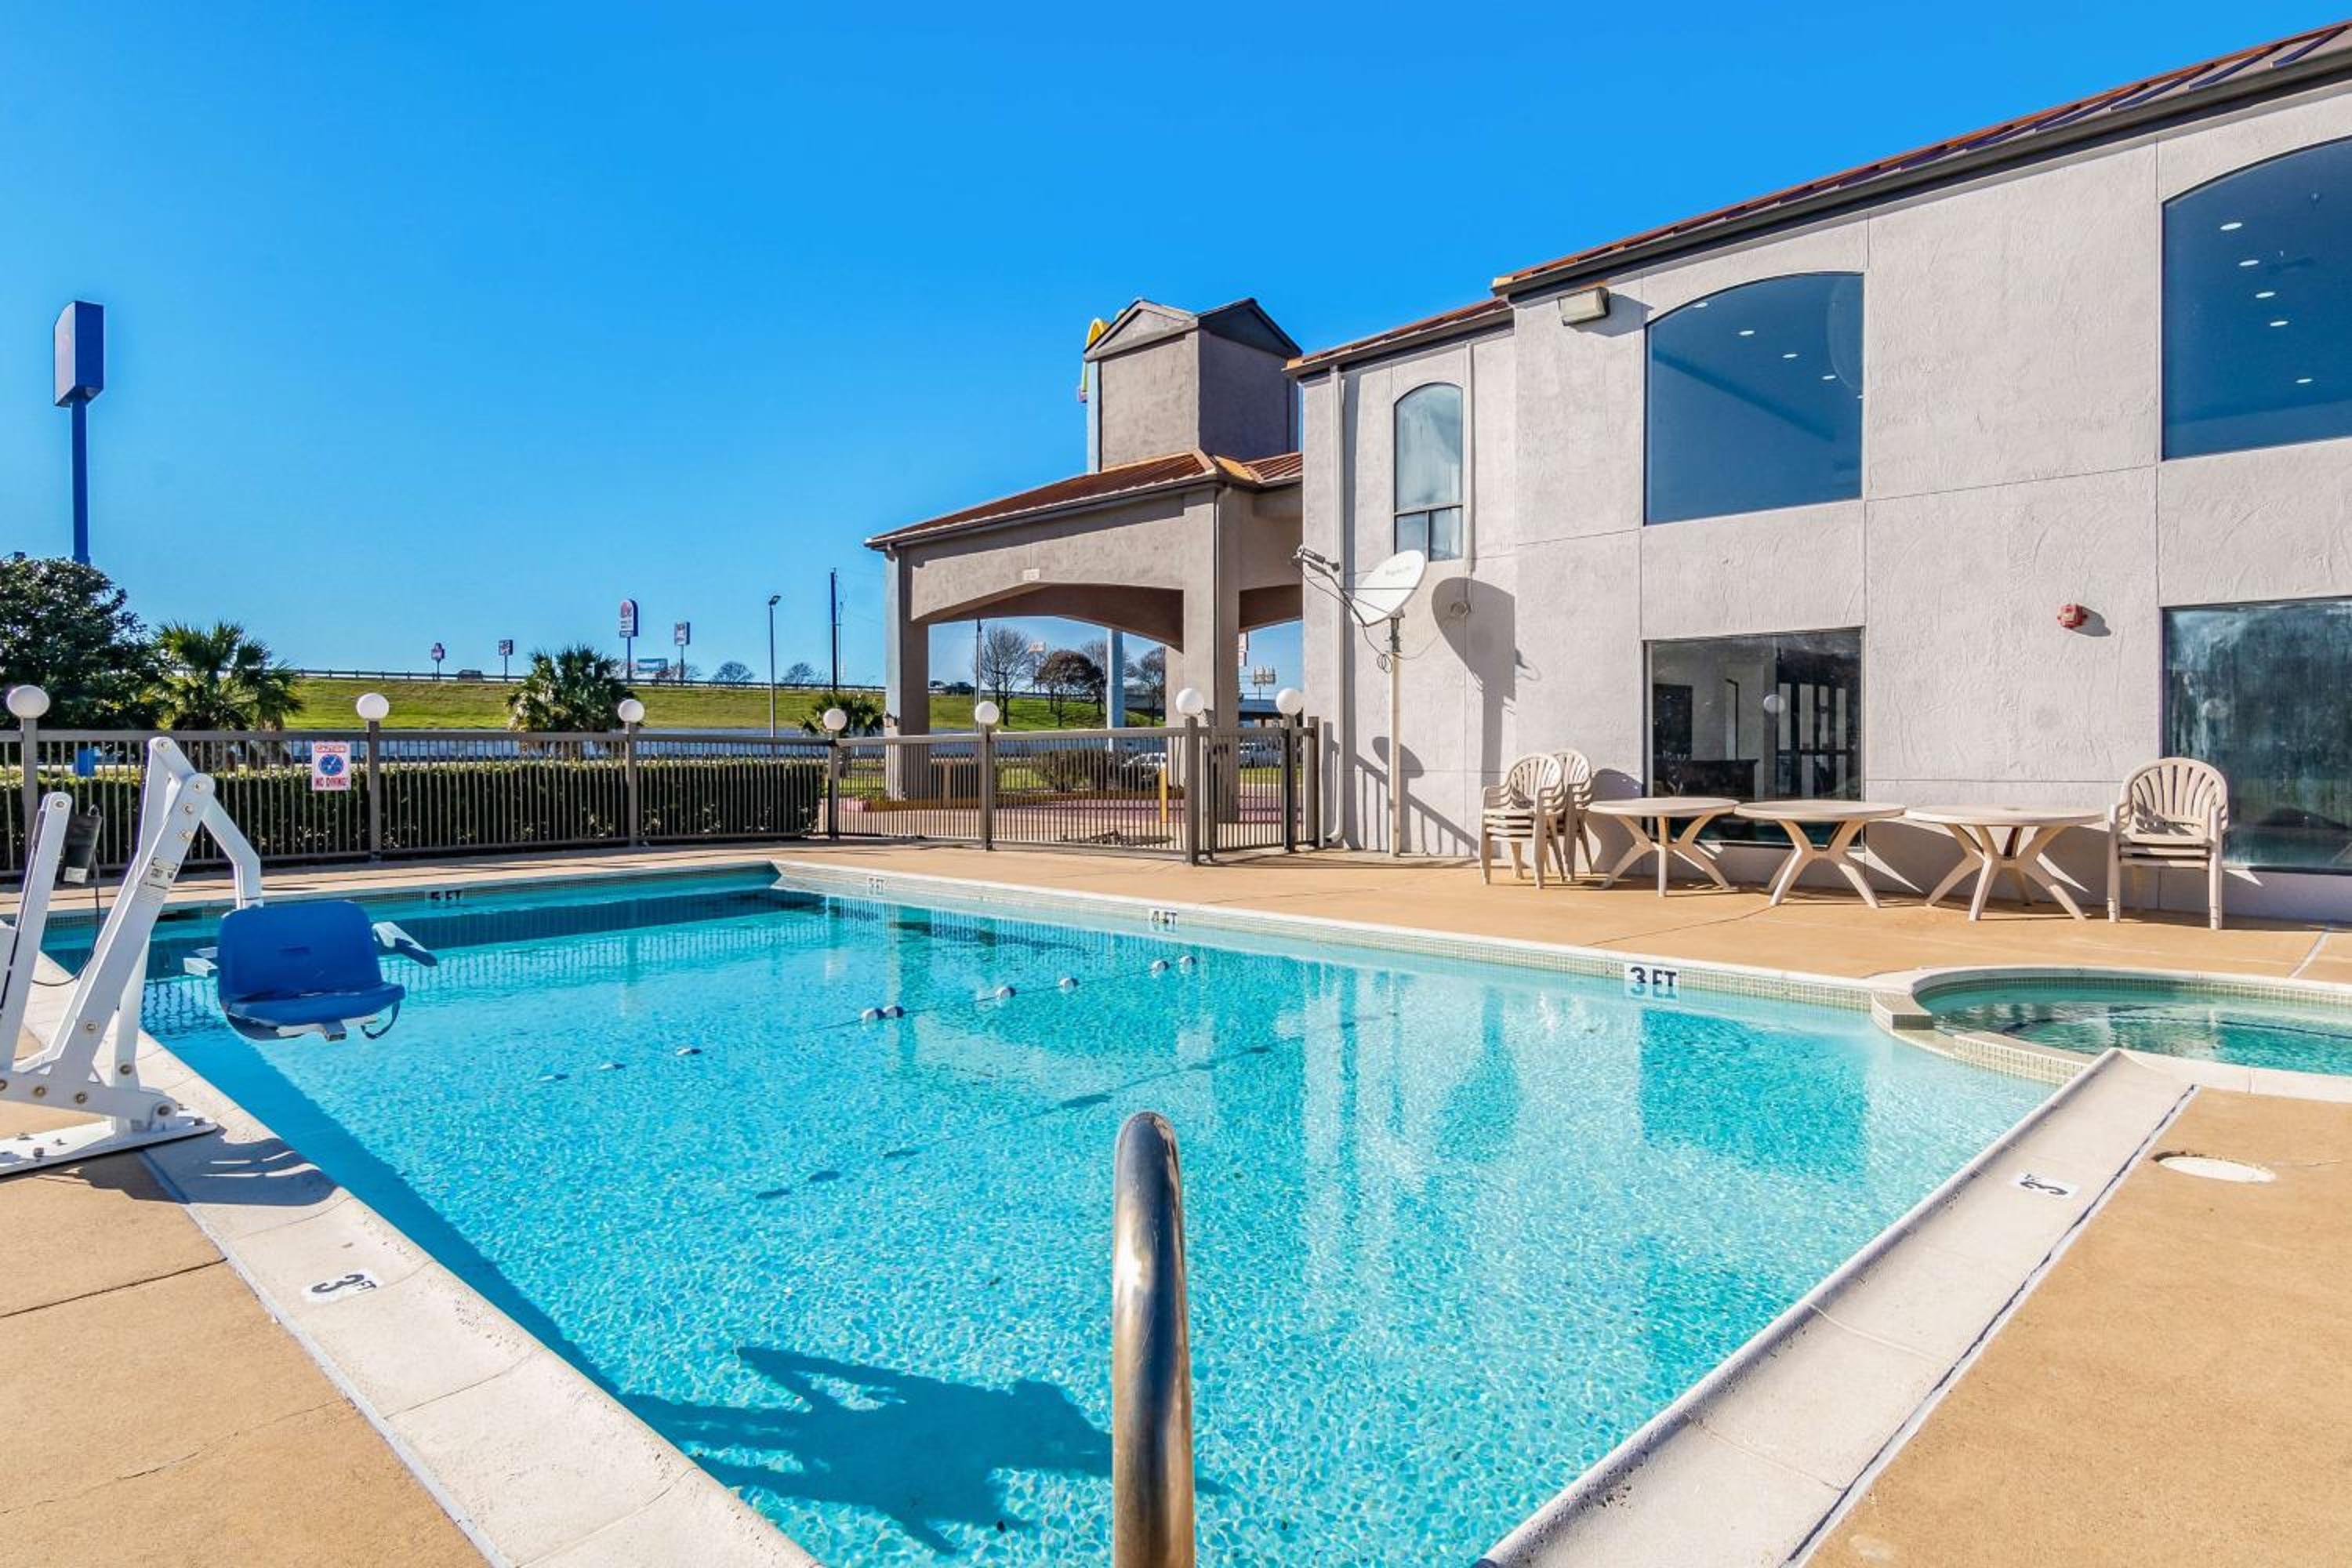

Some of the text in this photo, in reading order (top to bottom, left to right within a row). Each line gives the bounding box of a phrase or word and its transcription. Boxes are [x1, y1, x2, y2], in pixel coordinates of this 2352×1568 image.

[445, 889, 462, 901] FT
[1630, 966, 1677, 987] 3 FT
[311, 1274, 365, 1293] 3
